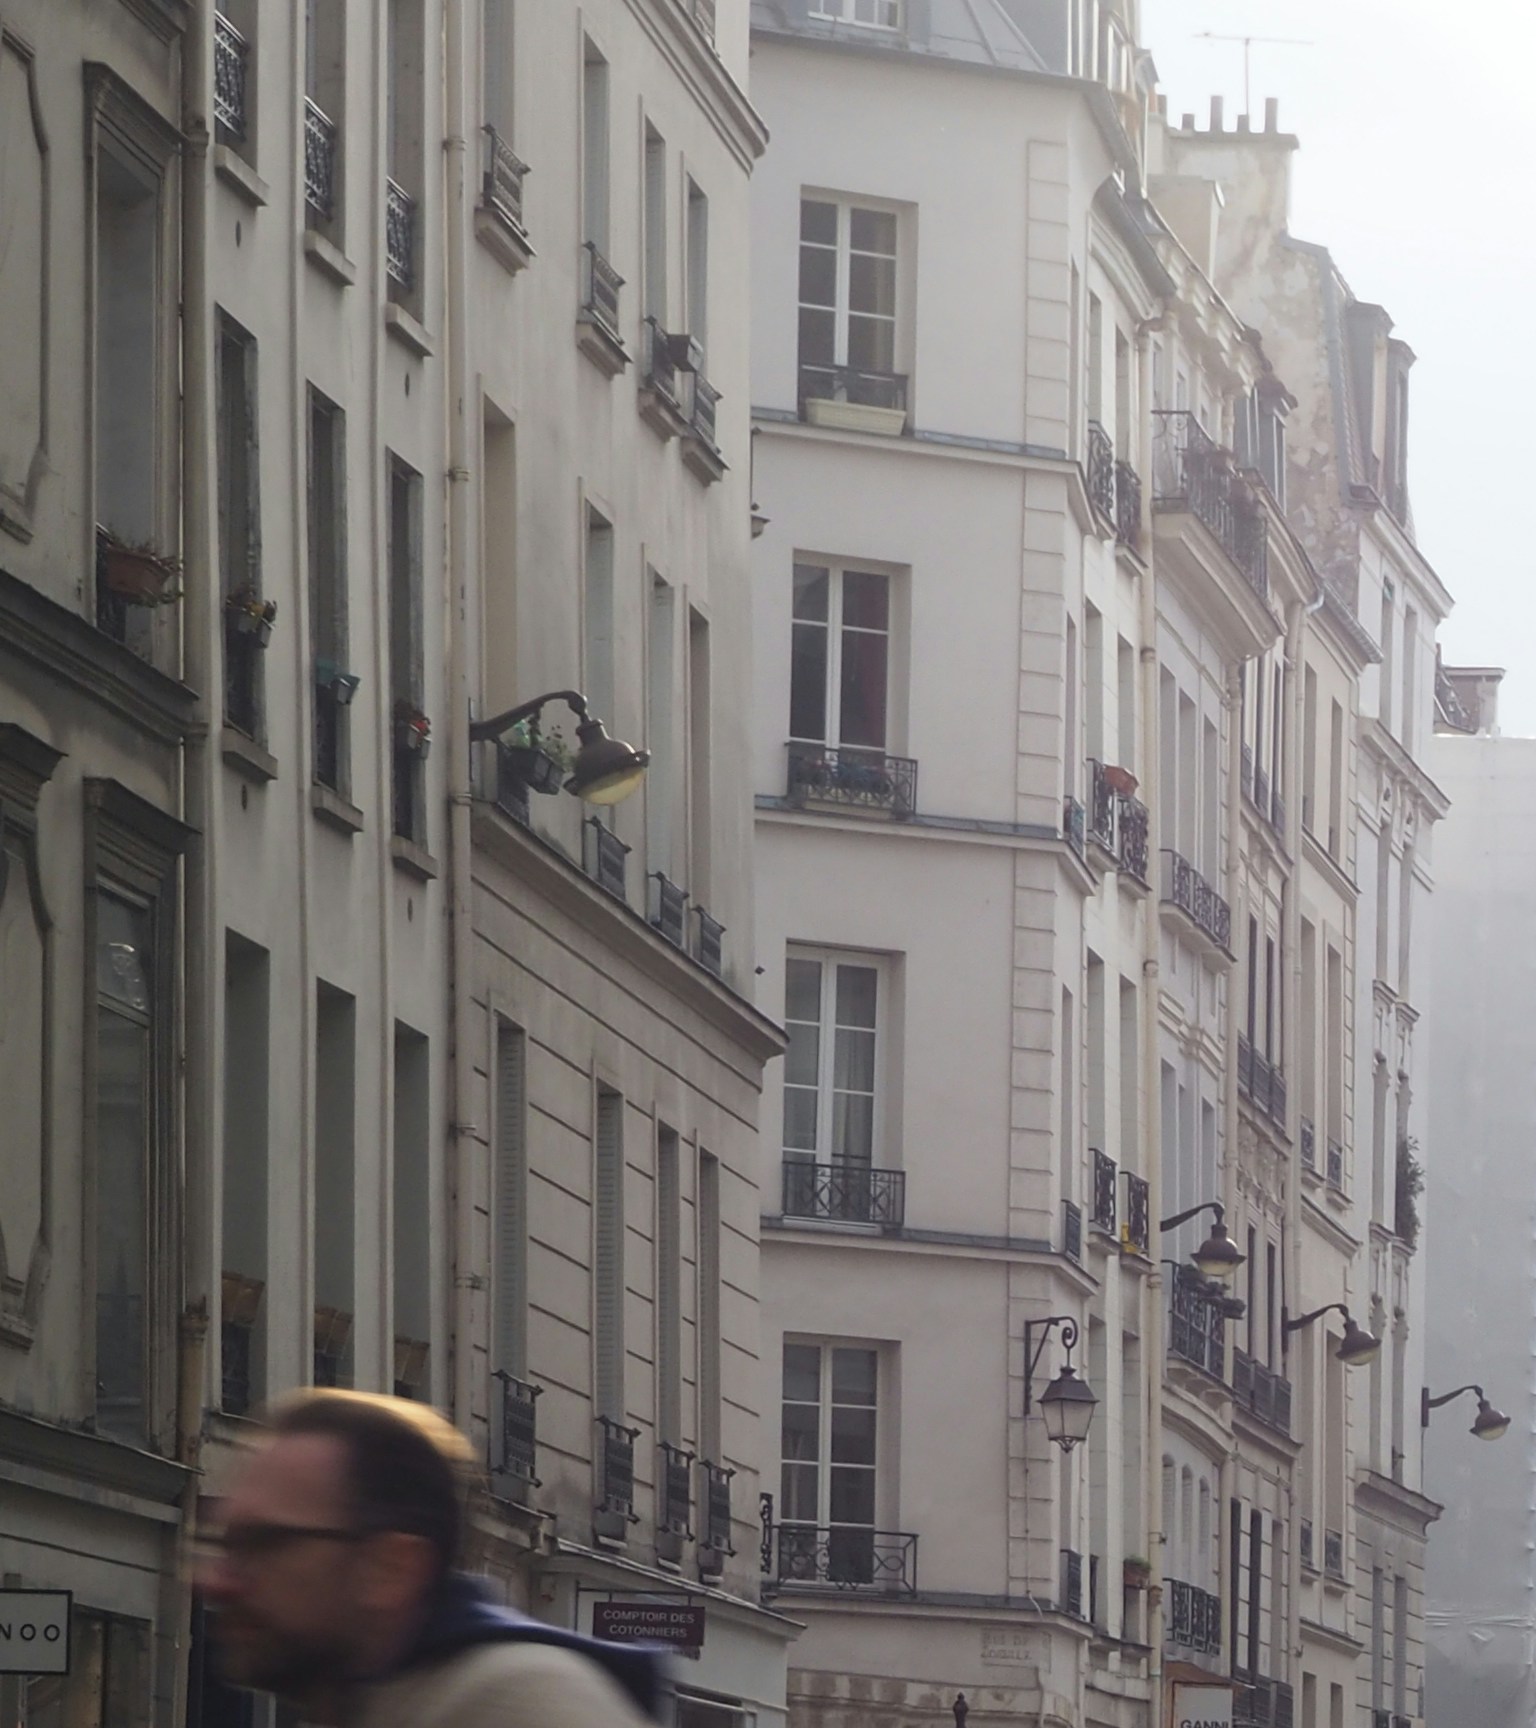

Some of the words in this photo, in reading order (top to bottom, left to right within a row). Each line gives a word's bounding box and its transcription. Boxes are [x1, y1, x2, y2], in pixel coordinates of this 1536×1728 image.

[603, 1609, 667, 1621] COMPTOIR
[670, 1612, 695, 1623] DES
[609, 1624, 687, 1637] COTONNIERS
